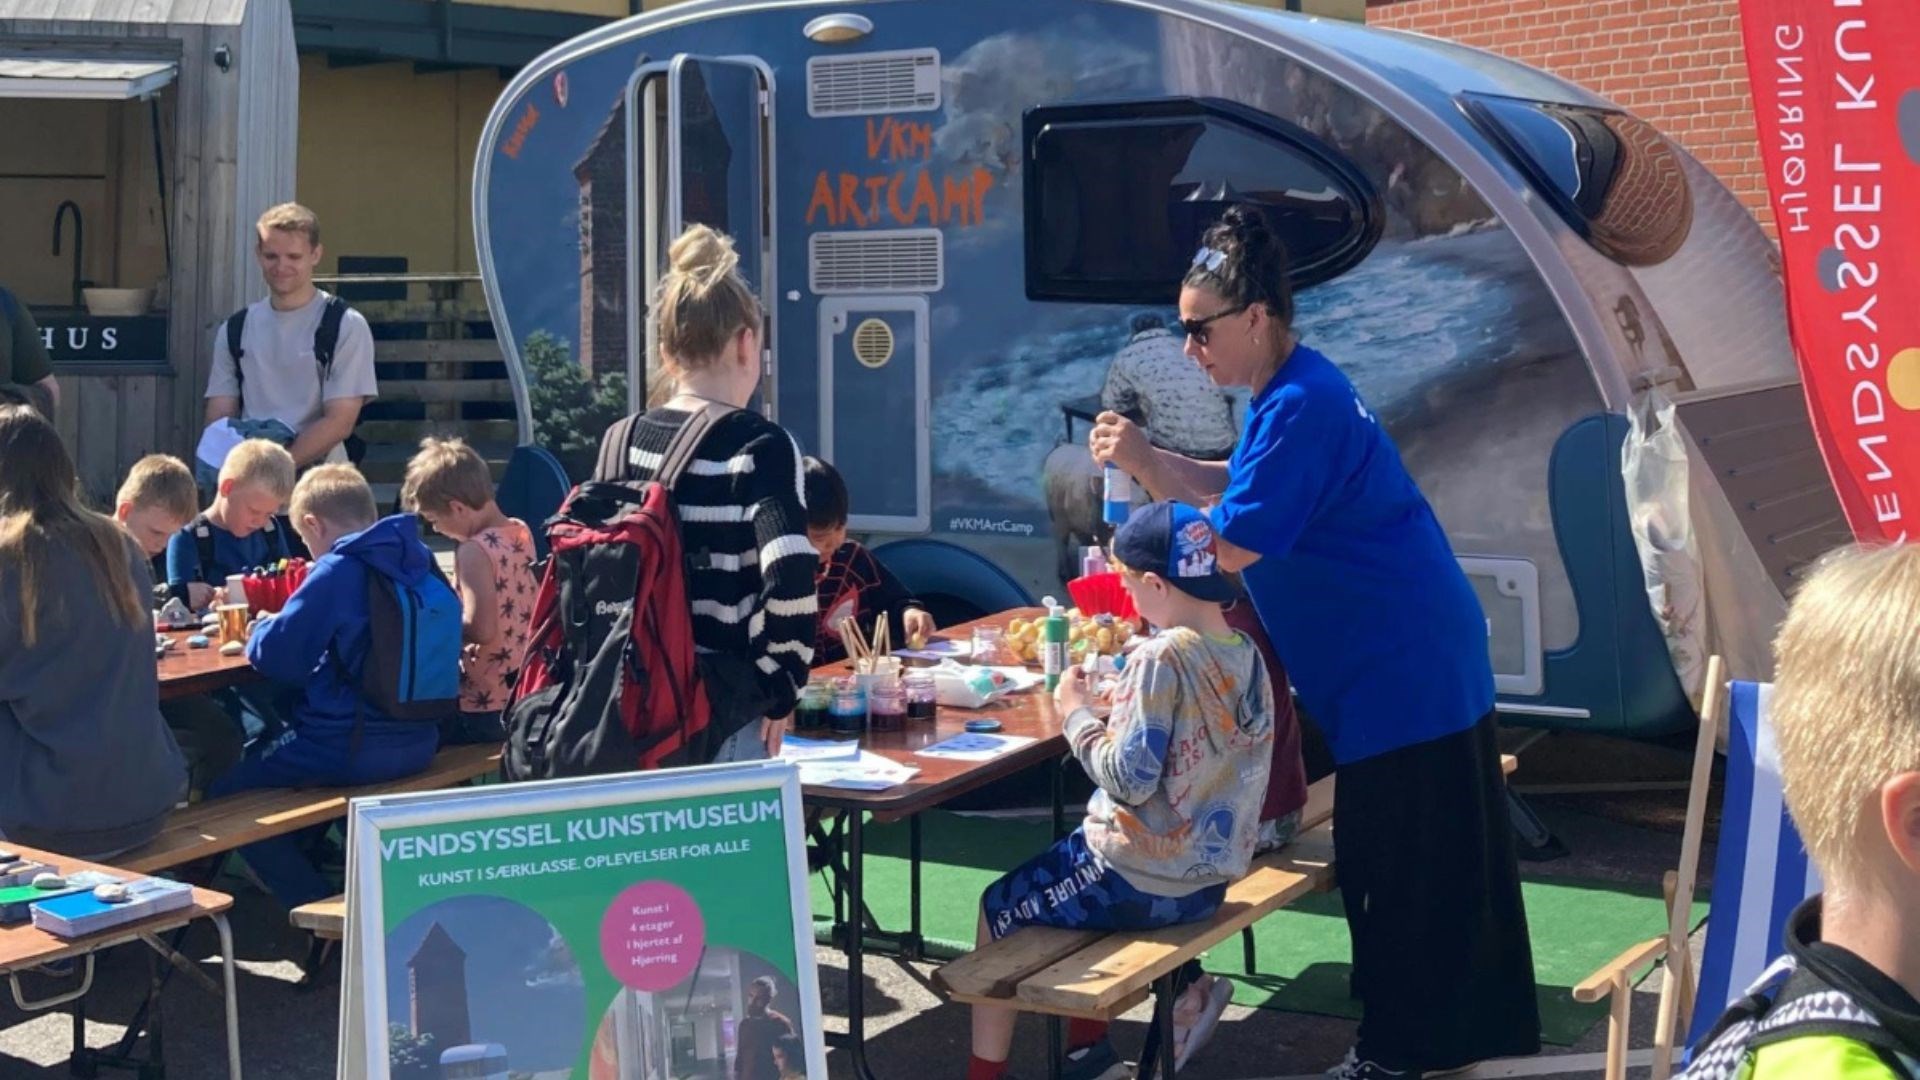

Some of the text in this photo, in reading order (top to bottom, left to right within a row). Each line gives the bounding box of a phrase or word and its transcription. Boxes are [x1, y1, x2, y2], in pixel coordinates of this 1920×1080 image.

[865, 116, 933, 163] VKM
[805, 167, 994, 229] ARTCAMP
[949, 517, 1034, 536] #VKMArtCamp
[380, 799, 782, 862] VENDSYSSEL KUNSTMUSEUM
[418, 839, 751, 887] KUNST I SÆRKLASSE. OPLEVELSER FOR ALLE
[632, 905, 663, 915] Kunst
[629, 920, 675, 932] 4 etager
[632, 936, 670, 950] hjertet
[672, 933, 683, 944] af
[631, 953, 678, 968] Hjørring
